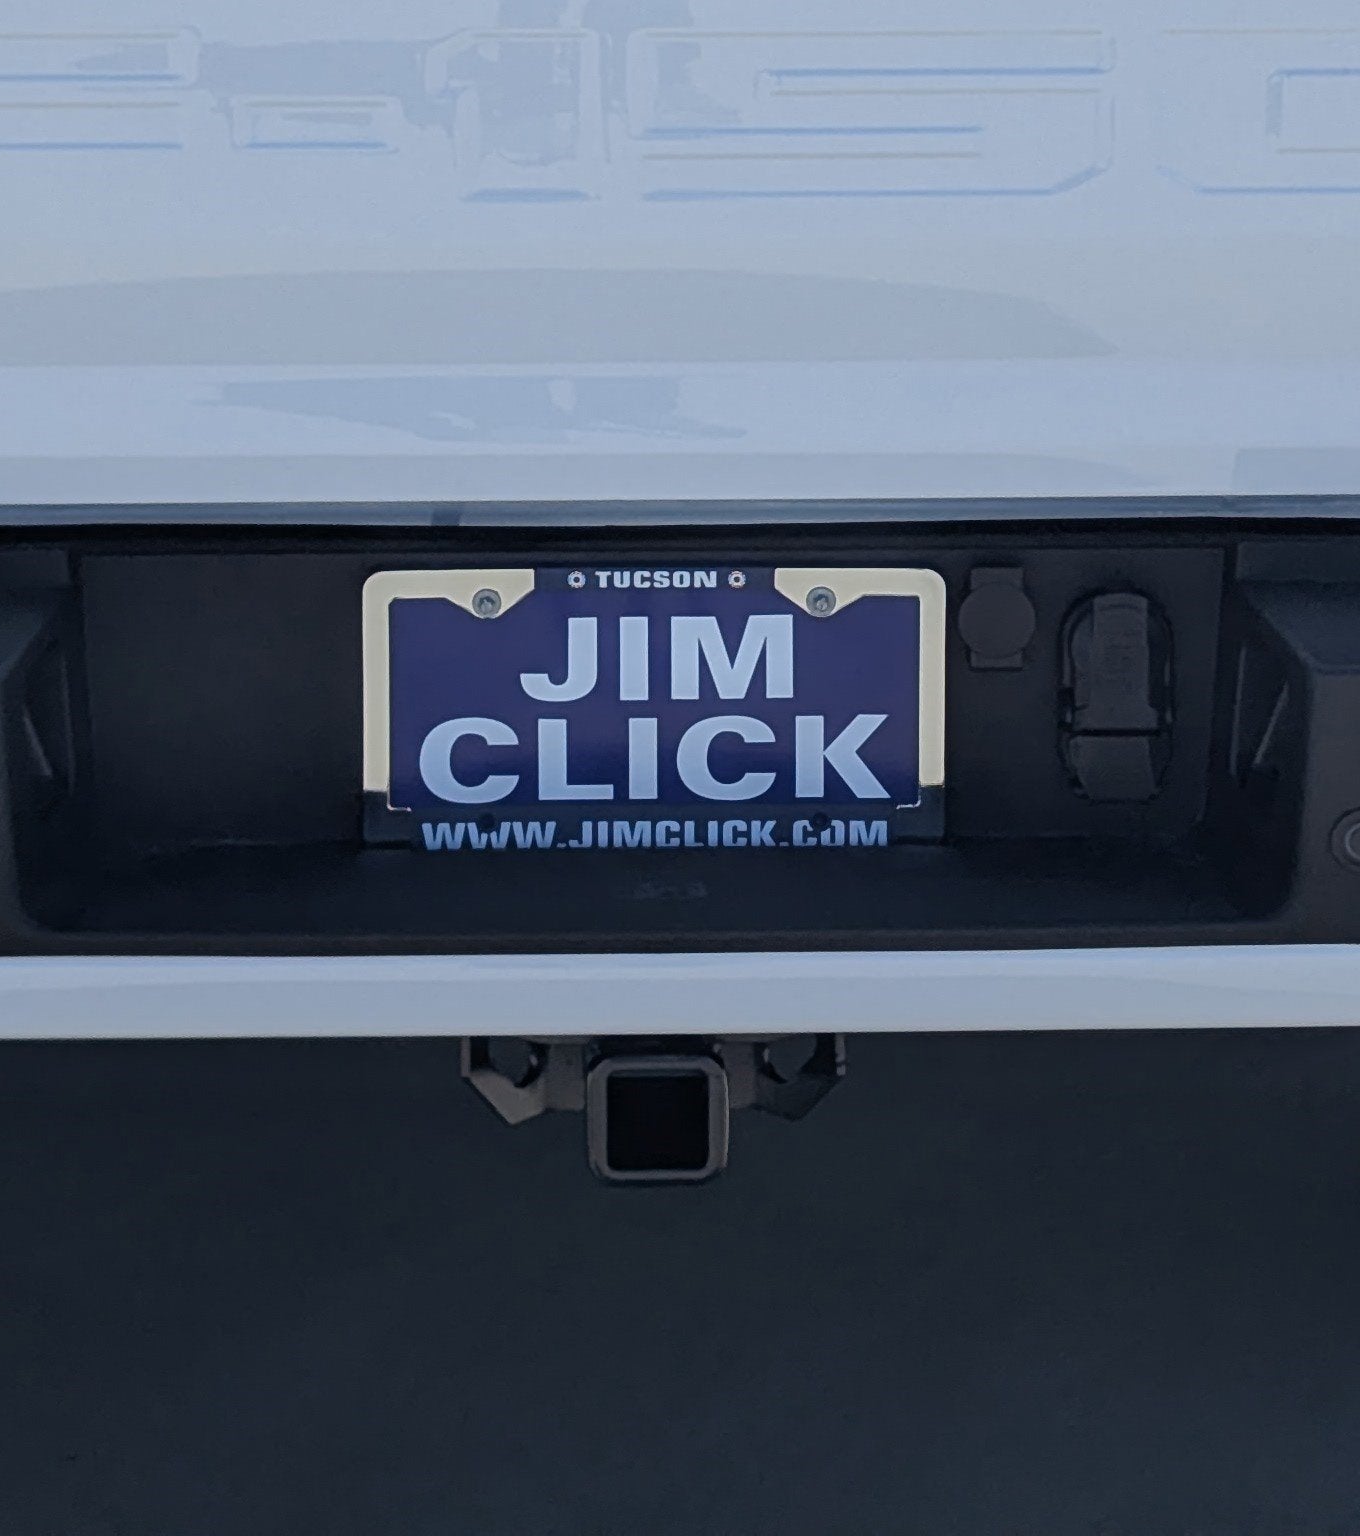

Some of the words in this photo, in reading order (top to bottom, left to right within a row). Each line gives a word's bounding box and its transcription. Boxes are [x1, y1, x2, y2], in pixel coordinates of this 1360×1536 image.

[595, 570, 717, 589] TUCSON
[520, 614, 793, 702] JIM
[419, 713, 891, 804] CLICK
[421, 820, 889, 850] WWW.JIMCLICK.COM
